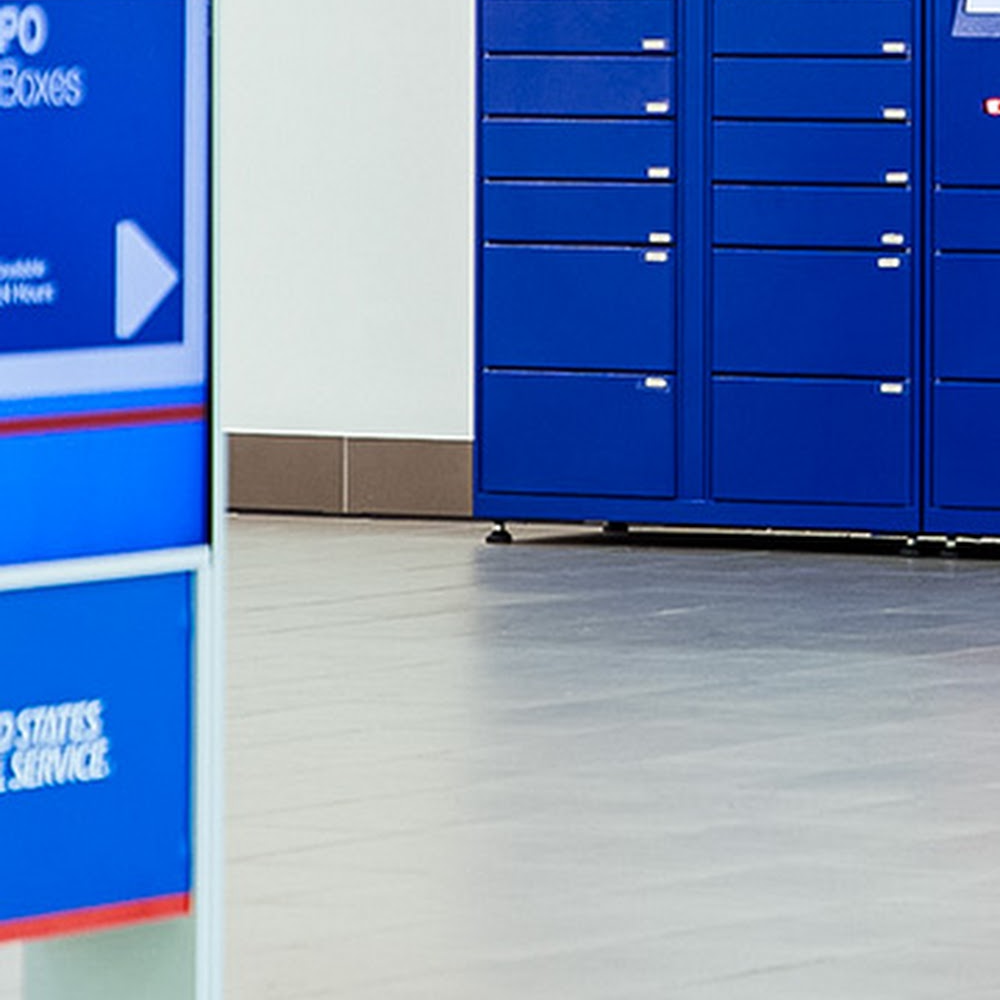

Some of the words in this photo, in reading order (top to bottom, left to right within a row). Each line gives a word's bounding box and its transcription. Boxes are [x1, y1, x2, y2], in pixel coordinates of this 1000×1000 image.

[0, 4, 48, 55] PO
[0, 58, 85, 107] Boxes
[15, 699, 102, 752] STATES
